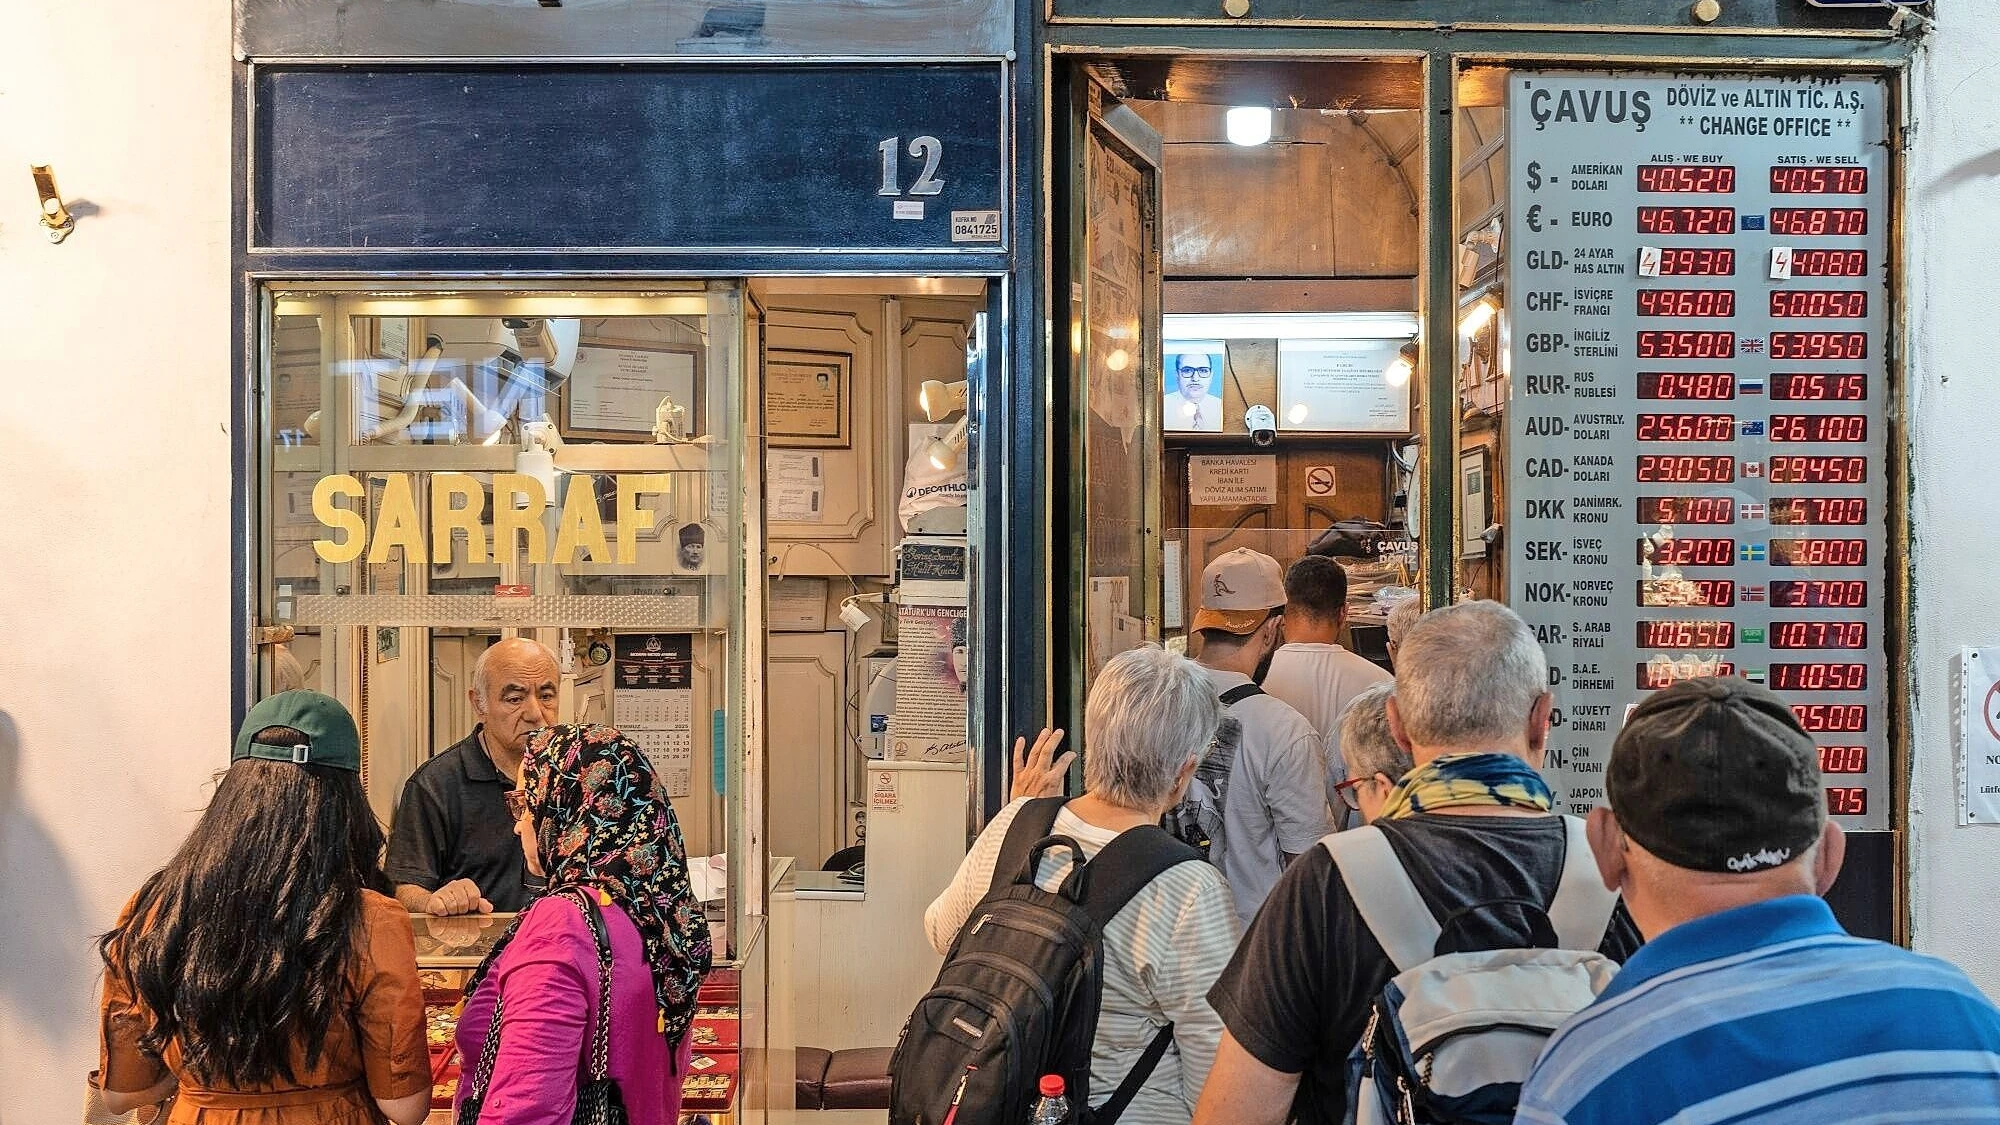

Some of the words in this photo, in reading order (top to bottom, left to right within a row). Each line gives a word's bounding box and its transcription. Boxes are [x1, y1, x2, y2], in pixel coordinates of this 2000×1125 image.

[1667, 84, 1716, 106] DÖVİZ
[1721, 94, 1738, 107] ve
[1744, 89, 1791, 107] ALTIN
[1797, 84, 1828, 108] TİC.
[1834, 91, 1864, 114] A.Ş.
[1531, 89, 1651, 132] ÇAVUŞ
[1700, 116, 1767, 135] CHANGE
[1774, 118, 1830, 136] OFFICE
[1702, 155, 1722, 163] BUY
[1835, 156, 1859, 164] SELL
[878, 136, 945, 195] 12
[1571, 165, 1622, 175] AMERİKAN
[1527, 161, 1542, 192] $
[1642, 169, 1732, 192] 40.520
[1774, 170, 1864, 192] 40.570
[1572, 180, 1607, 190] DOLARI
[1526, 205, 1542, 232] €
[1572, 212, 1612, 227] EURO
[1642, 210, 1732, 233] 46.720
[1773, 211, 1863, 234] 46.870
[955, 225, 997, 235] 0841725
[1575, 248, 1585, 258] 24
[1589, 248, 1613, 258] AYAR
[1574, 264, 1593, 273] HAS
[1597, 264, 1624, 274] ALTIN
[1575, 290, 1613, 302] İSVİÇRE
[1574, 305, 1610, 315] FRANGI
[1640, 292, 1732, 317] 49.600
[1773, 293, 1863, 316] 50.050
[1574, 331, 1610, 341] İNGİLİZ
[1641, 333, 1731, 357] 53.500
[1773, 335, 1863, 358] 53.950
[1574, 347, 1617, 357] STERLİNİ
[1575, 372, 1593, 382] RUS
[1575, 388, 1615, 397] RUBLESİ
[1657, 375, 1731, 400] 0.480
[1790, 376, 1861, 399] 0.515
[1574, 414, 1624, 424] AVUSTRLY.
[1639, 417, 1732, 439] 25.600
[1771, 417, 1863, 440] 26.100
[1574, 430, 1609, 439] DOLARI
[1574, 456, 1613, 466] KANADA
[1639, 458, 1732, 481] 29.050
[1771, 459, 1863, 482] 29.450
[1574, 472, 1609, 481] DOLARI
[918, 483, 967, 496] DECATHLO
[1574, 498, 1621, 507] DANİMRK.
[1526, 500, 1564, 519] DKK
[1659, 499, 1732, 522] 5.100
[1791, 500, 1863, 523] 5.700
[312, 473, 671, 565] SARRAF
[1574, 513, 1608, 523] KRONU
[1377, 541, 1419, 552] ÇAVUŞ
[1574, 539, 1601, 549] İSVEÇ
[1573, 555, 1607, 564] KRONU
[1573, 581, 1613, 590] NORVEÇ
[1791, 583, 1863, 606] 3.700
[1573, 596, 1607, 606] KRONU
[1573, 622, 1581, 632] S.
[1585, 623, 1610, 632] ARAB
[1648, 624, 1732, 647] 10.650
[1780, 624, 1863, 648] 10.770
[1573, 638, 1603, 647] RİYALİ
[1573, 664, 1600, 673] B.A.E.
[1780, 666, 1863, 689] 11.050
[1573, 680, 1613, 689] DİRHEMİ
[1573, 706, 1610, 715] KUVEYT
[1573, 721, 1605, 731] DİNARI
[1572, 747, 1588, 757] ÇİN
[1572, 763, 1601, 772] YUANI
[1570, 788, 1602, 798] JAPON
[1570, 802, 1593, 814] YENİ
